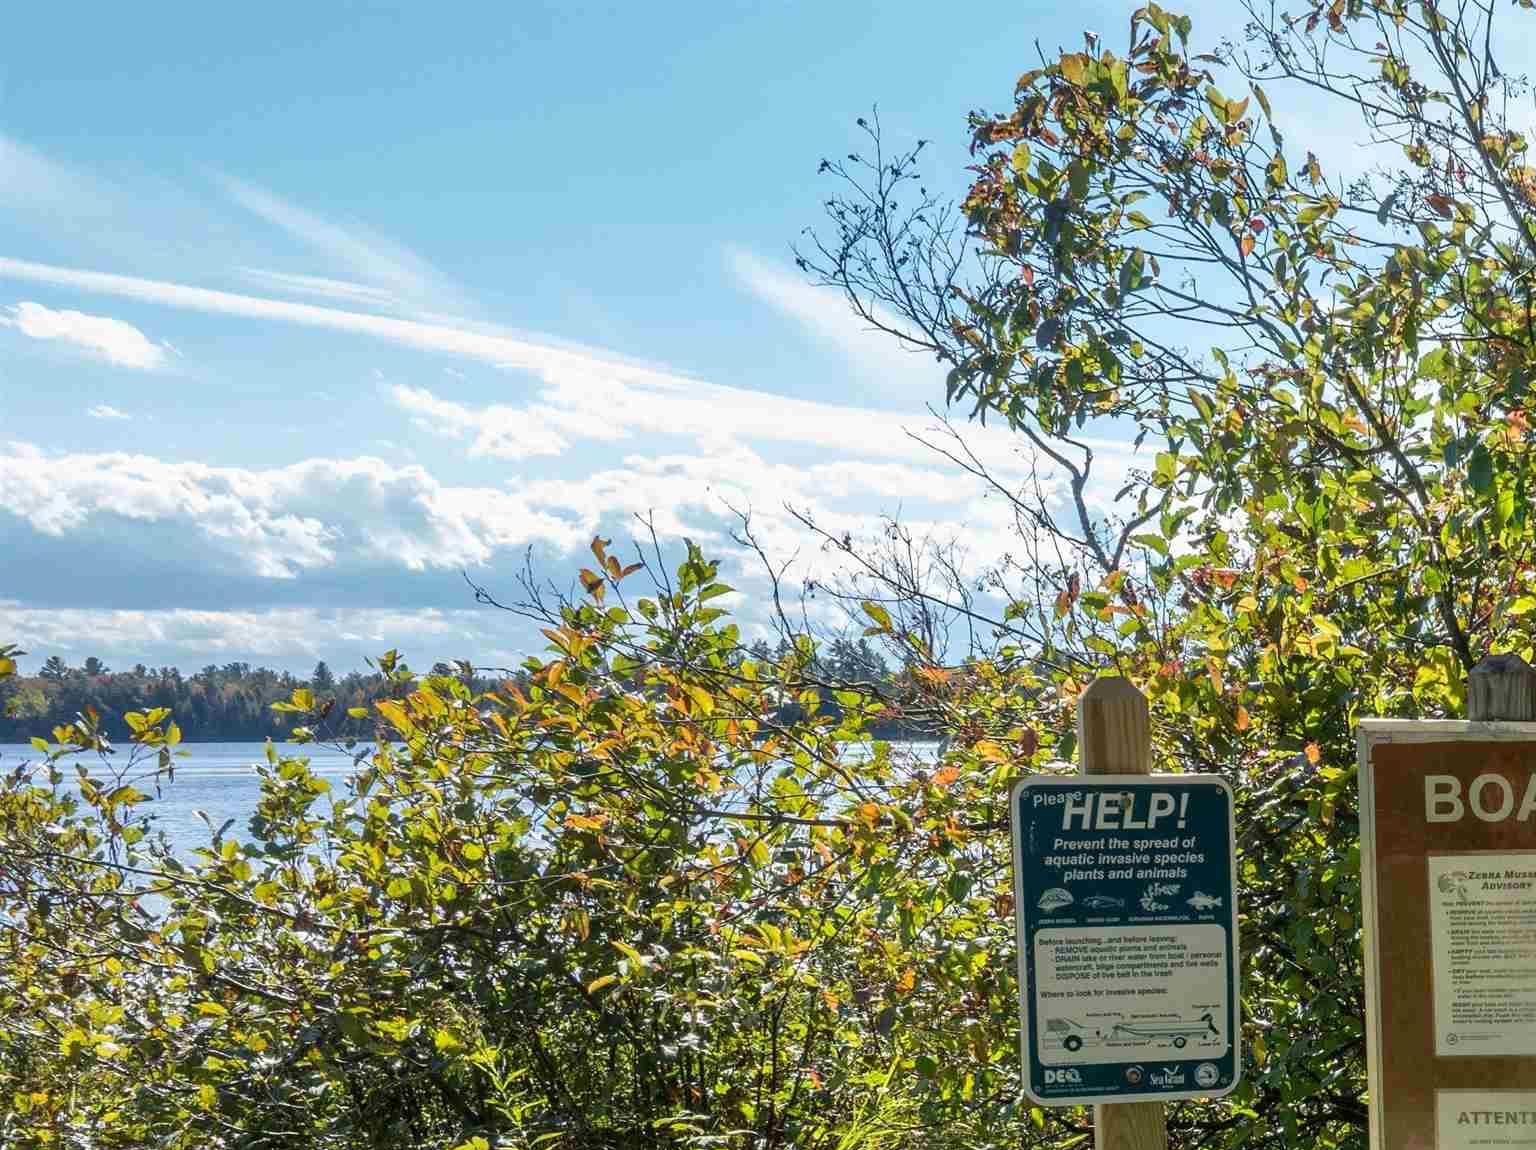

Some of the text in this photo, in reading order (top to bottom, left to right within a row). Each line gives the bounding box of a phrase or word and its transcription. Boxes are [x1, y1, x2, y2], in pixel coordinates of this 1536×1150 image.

[1062, 791, 1190, 831] HELP!
[1054, 836, 1196, 851] Prevent the spread of
[1045, 852, 1205, 868] aquatic invasive species
[1063, 867, 1188, 883] plants and animals
